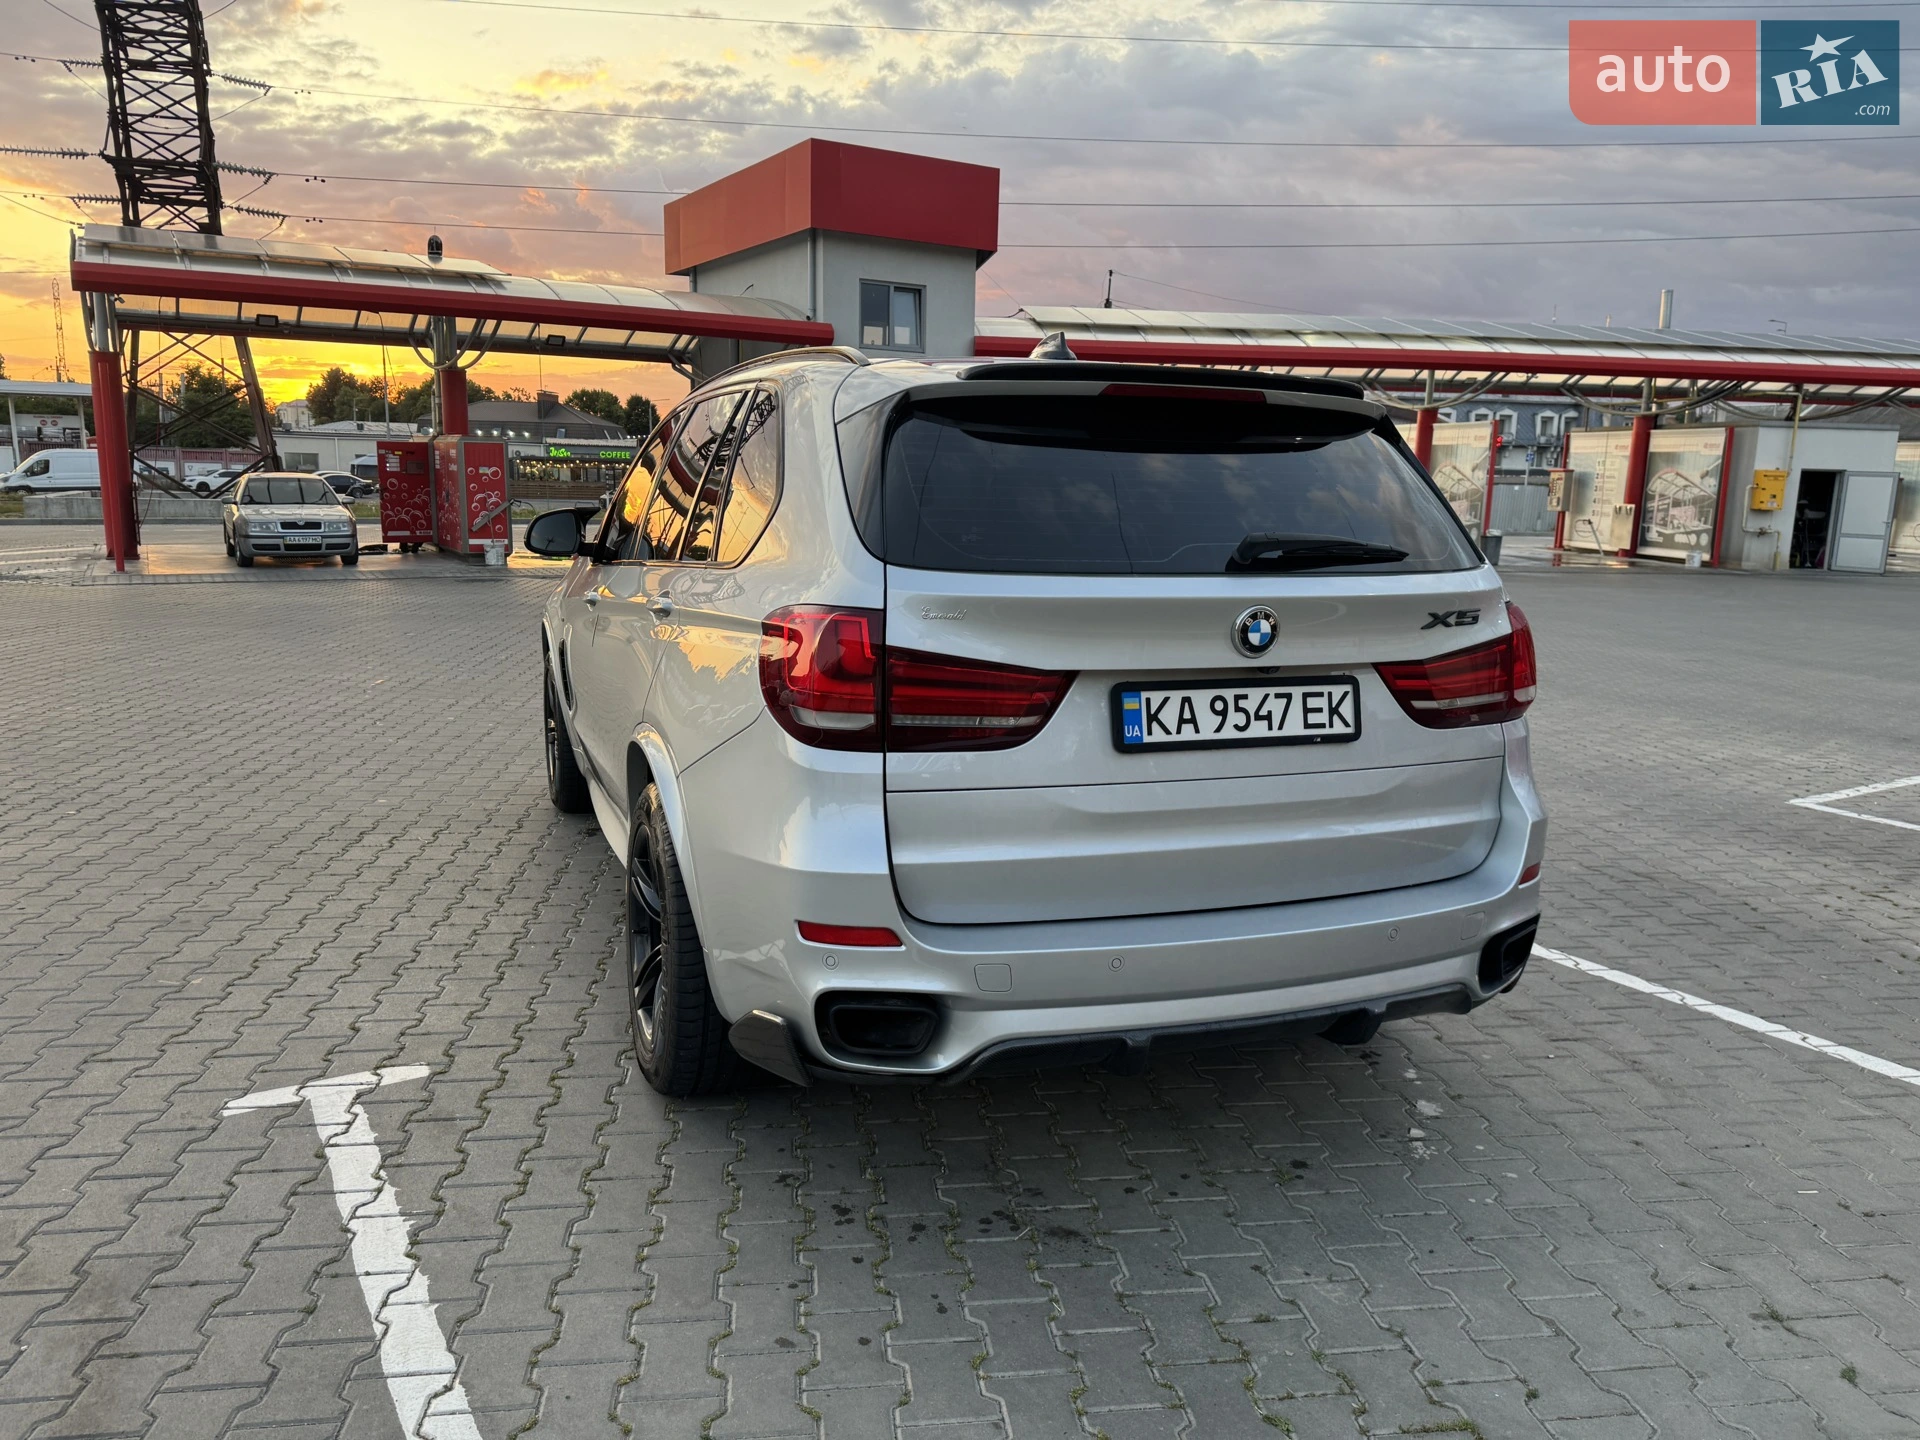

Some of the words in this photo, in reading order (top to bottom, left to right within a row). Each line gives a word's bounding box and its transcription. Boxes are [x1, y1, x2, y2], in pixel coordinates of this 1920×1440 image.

[600, 451, 631, 459] COFFEE
[921, 605, 967, 620] Emerald
[1244, 611, 1277, 626] BMW
[1420, 608, 1482, 630] X5
[1145, 695, 1200, 736] KA
[1209, 692, 1293, 734] 9547
[1302, 690, 1352, 730] EK
[1124, 724, 1141, 737] UA
